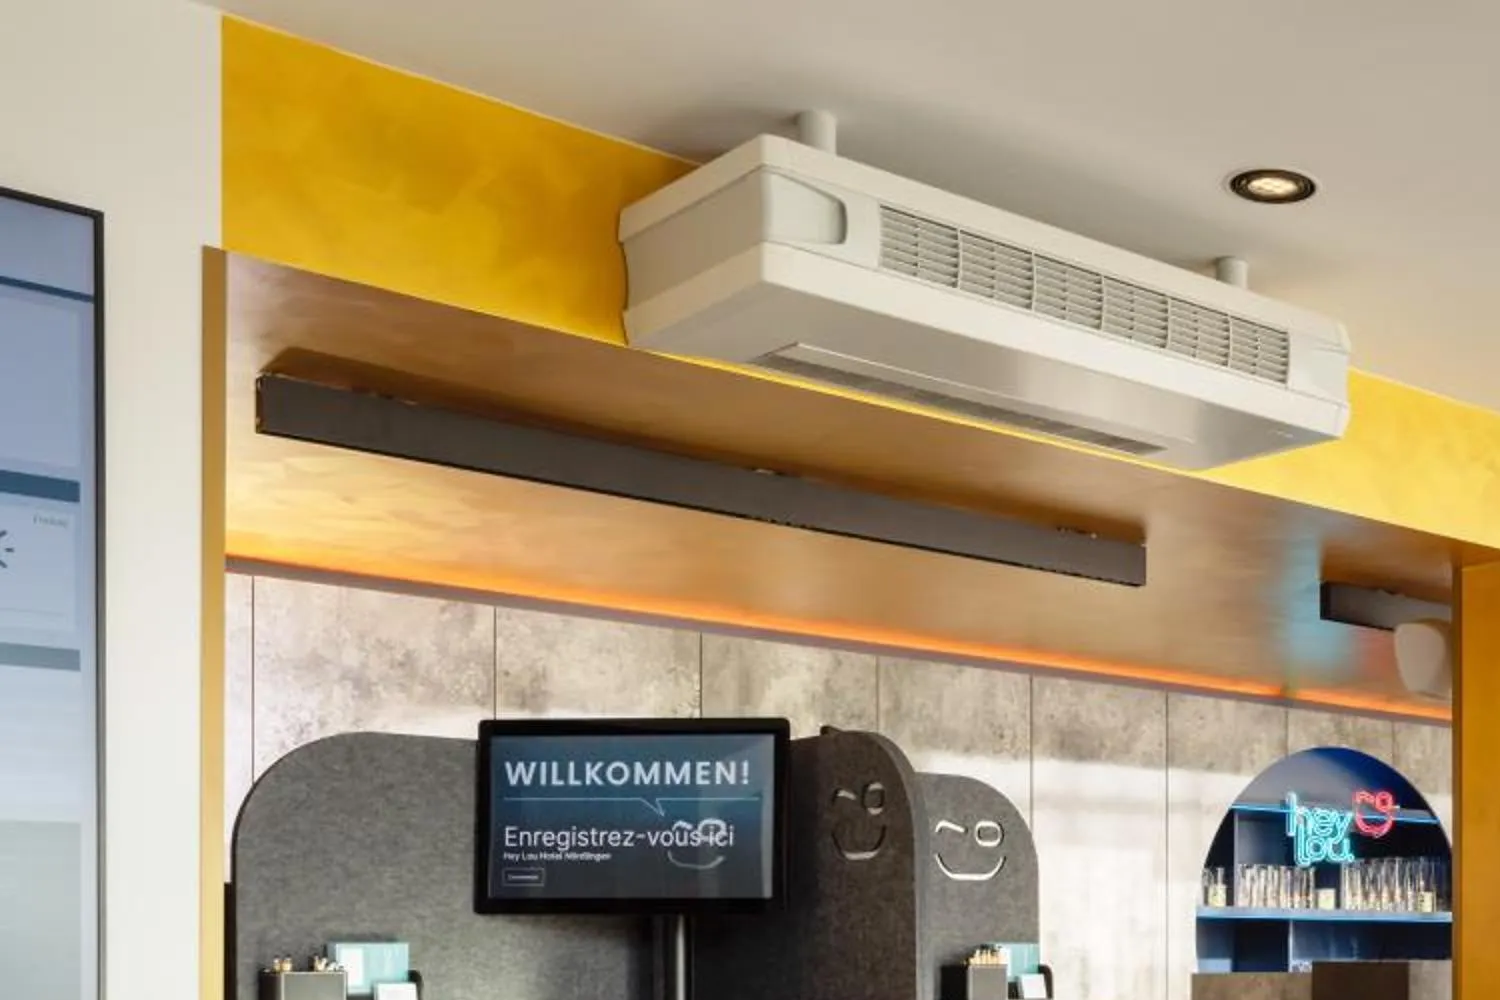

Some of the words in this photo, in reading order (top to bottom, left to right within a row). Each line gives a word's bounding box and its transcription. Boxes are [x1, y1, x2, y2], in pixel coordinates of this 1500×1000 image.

[504, 760, 751, 786] WILLKOMMEN!
[1285, 791, 1352, 844] hey
[503, 825, 702, 851] Enregistrez-vous
[708, 824, 735, 847] ici
